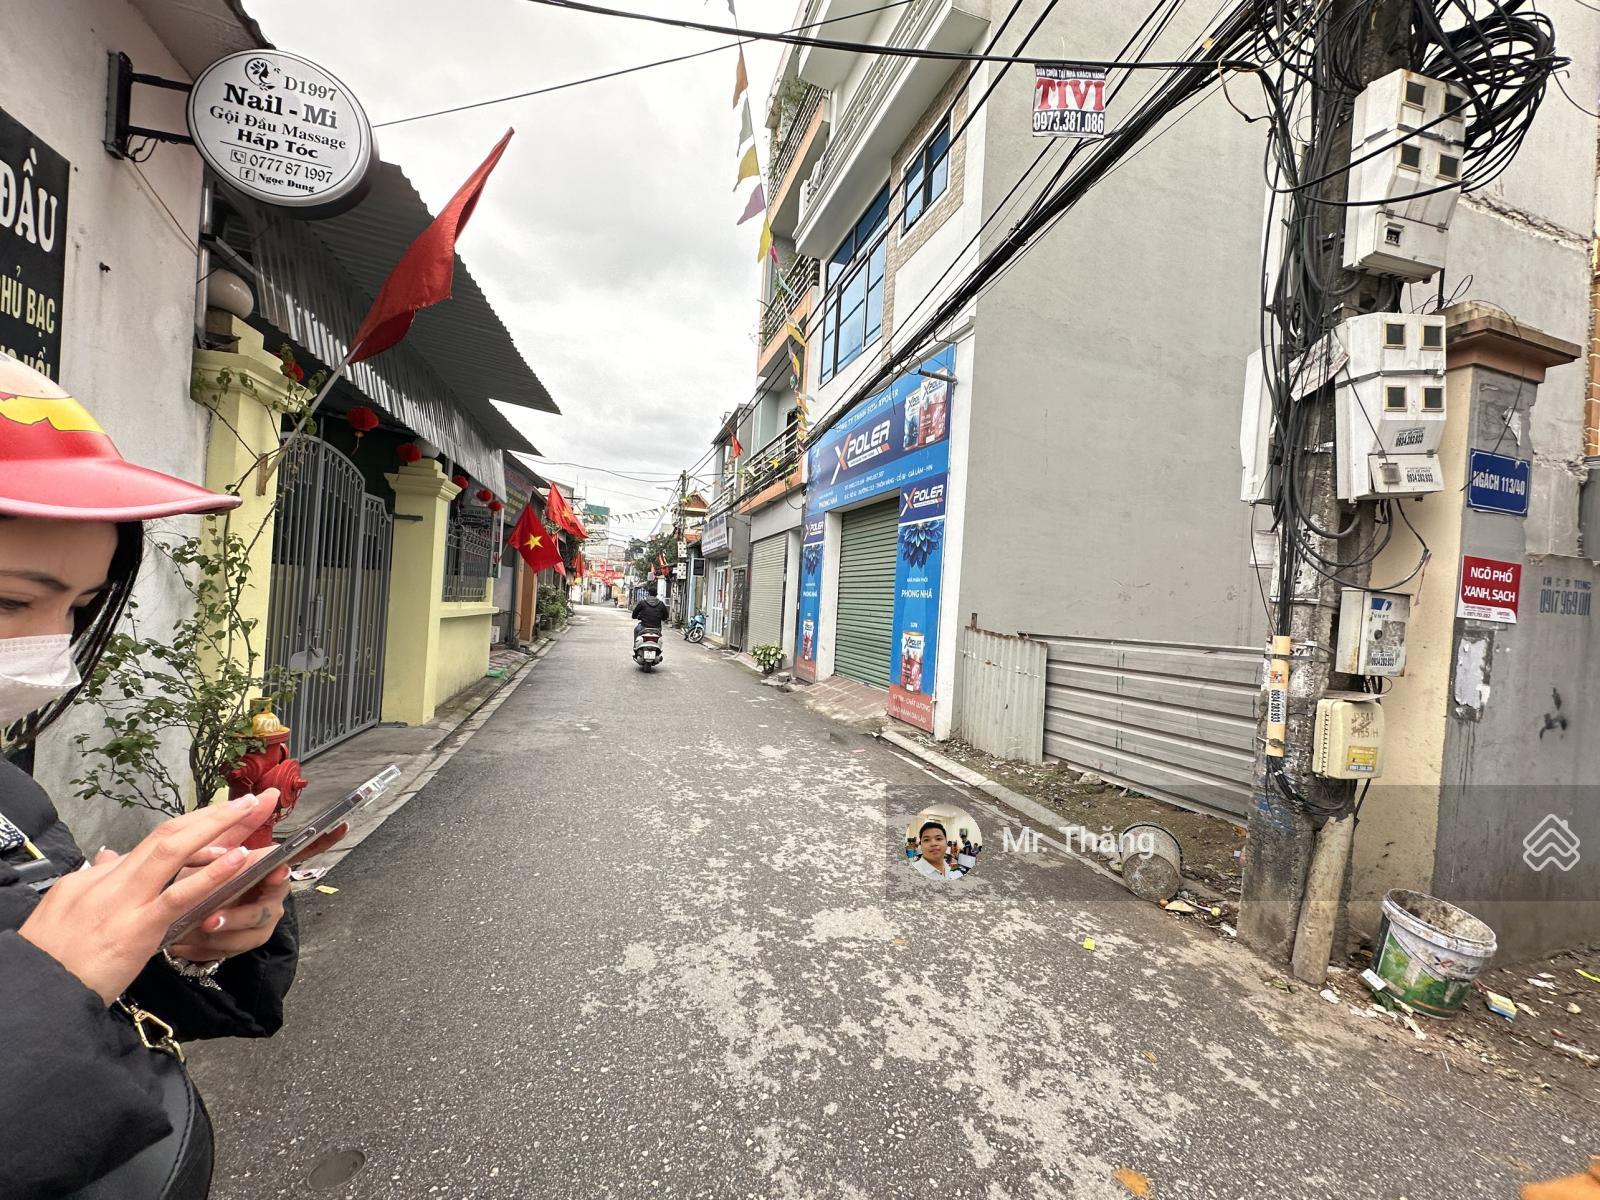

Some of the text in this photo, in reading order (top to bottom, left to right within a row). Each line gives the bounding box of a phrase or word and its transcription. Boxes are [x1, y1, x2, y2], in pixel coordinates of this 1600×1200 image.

[284, 75, 337, 102] D1997
[1036, 78, 1105, 111] TIVI
[223, 82, 283, 116] Nail
[302, 103, 338, 129] Mi
[209, 105, 240, 124] Gội
[282, 123, 347, 151] Massage
[1033, 110, 1104, 134] 0973.381.086
[237, 129, 319, 159] Hấp Tóc
[250, 154, 333, 184] 0777 87 1997
[287, 179, 315, 193] Dung
[0, 265, 56, 339] HỦ BẠC
[830, 419, 891, 485] XPOLER
[1472, 468, 1525, 496] NGÁCH 113/40
[900, 484, 944, 517] XPOLER
[1470, 566, 1513, 583] NGÕ PHỐ
[901, 589, 920, 599] PHONG
[1464, 585, 1516, 603] XANH, SẠCH
